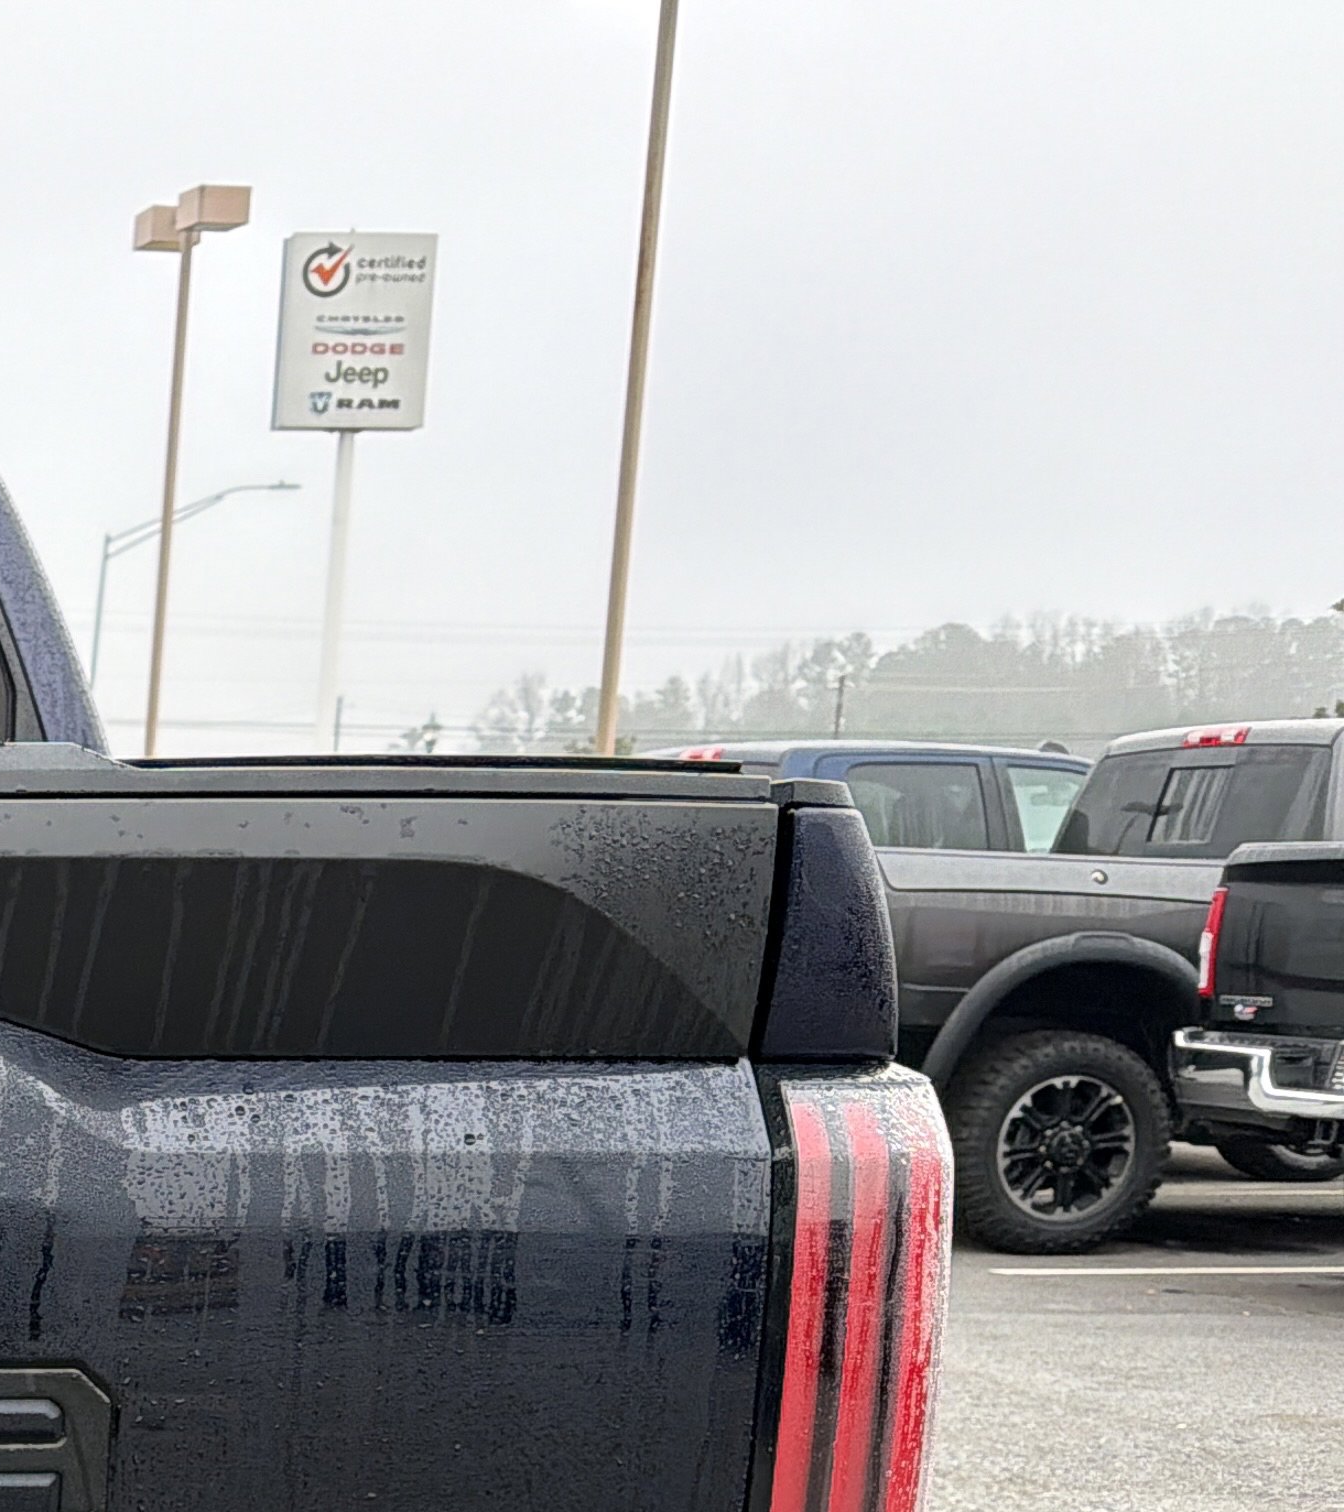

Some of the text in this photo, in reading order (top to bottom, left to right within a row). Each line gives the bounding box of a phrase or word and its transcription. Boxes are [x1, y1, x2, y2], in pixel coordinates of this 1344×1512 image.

[357, 256, 426, 269] certified
[355, 272, 426, 284] pre-owned
[316, 314, 405, 323] CHRYSLER
[311, 342, 405, 355] DODGE
[324, 360, 389, 389] Jeep
[335, 398, 402, 410] RAM
